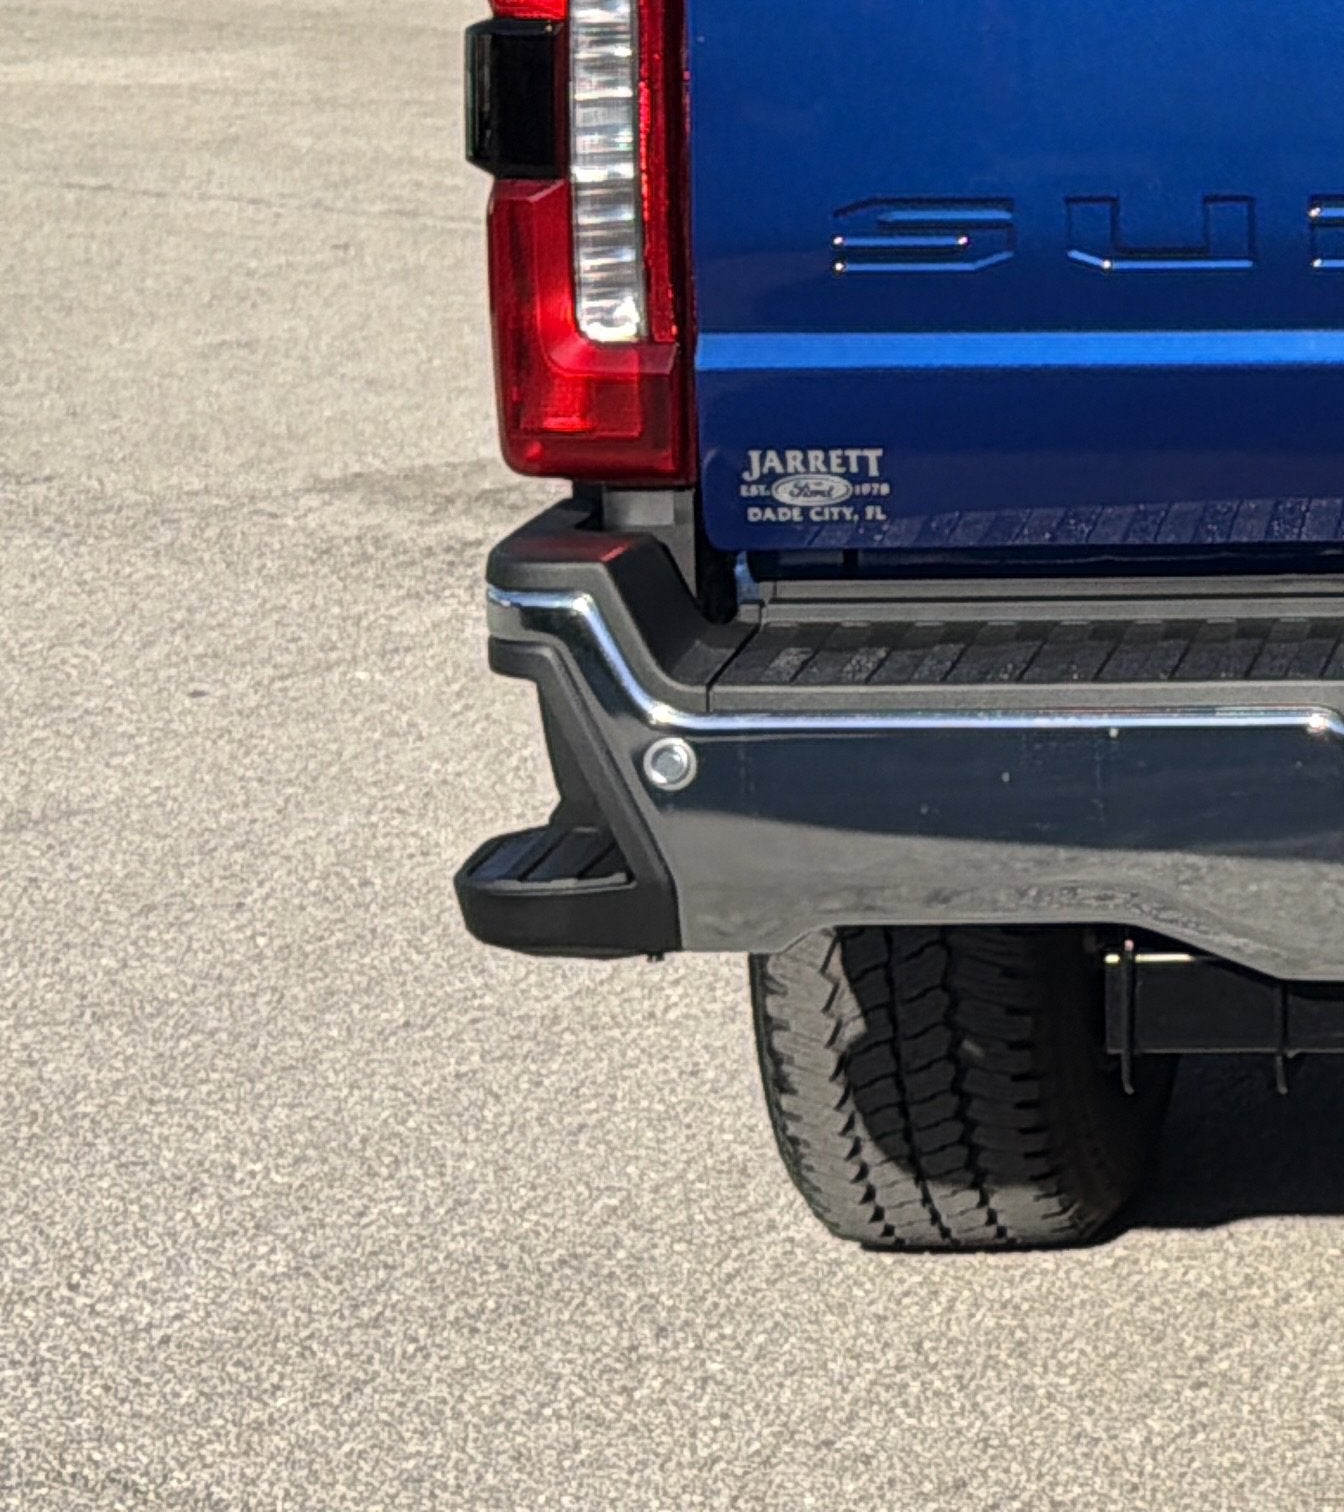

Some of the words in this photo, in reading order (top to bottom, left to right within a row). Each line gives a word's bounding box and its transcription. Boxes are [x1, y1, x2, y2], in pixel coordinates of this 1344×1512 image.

[742, 448, 884, 481] JARRETT
[788, 481, 835, 498] Ford
[747, 507, 803, 522] DADE
[809, 506, 859, 523] CITY,
[865, 505, 887, 520] FL
